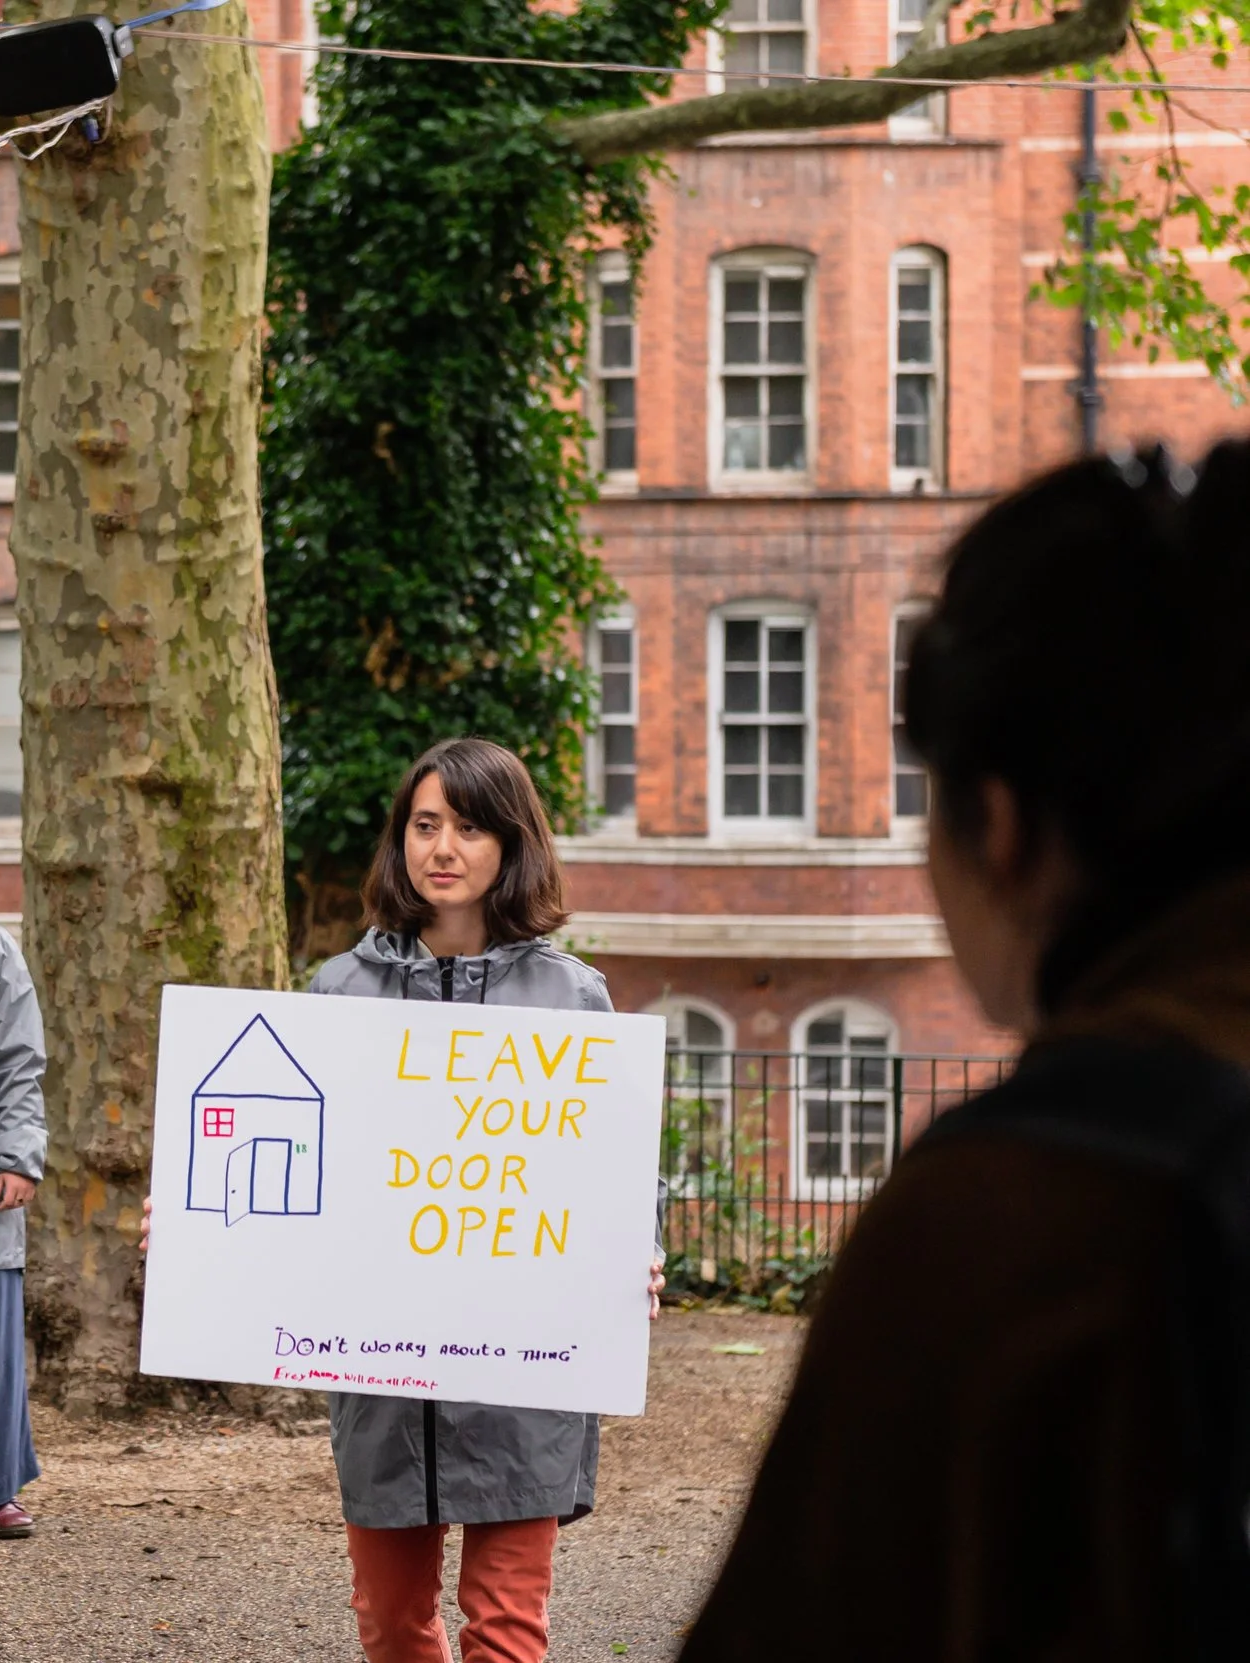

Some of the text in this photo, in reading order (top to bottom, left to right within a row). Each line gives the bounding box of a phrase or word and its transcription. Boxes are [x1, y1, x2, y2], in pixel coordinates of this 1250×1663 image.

[397, 1029, 615, 1084] LEAVE
[453, 1096, 587, 1141] YOUR
[387, 1149, 528, 1195] DOOR
[408, 1203, 570, 1258] OPEN
